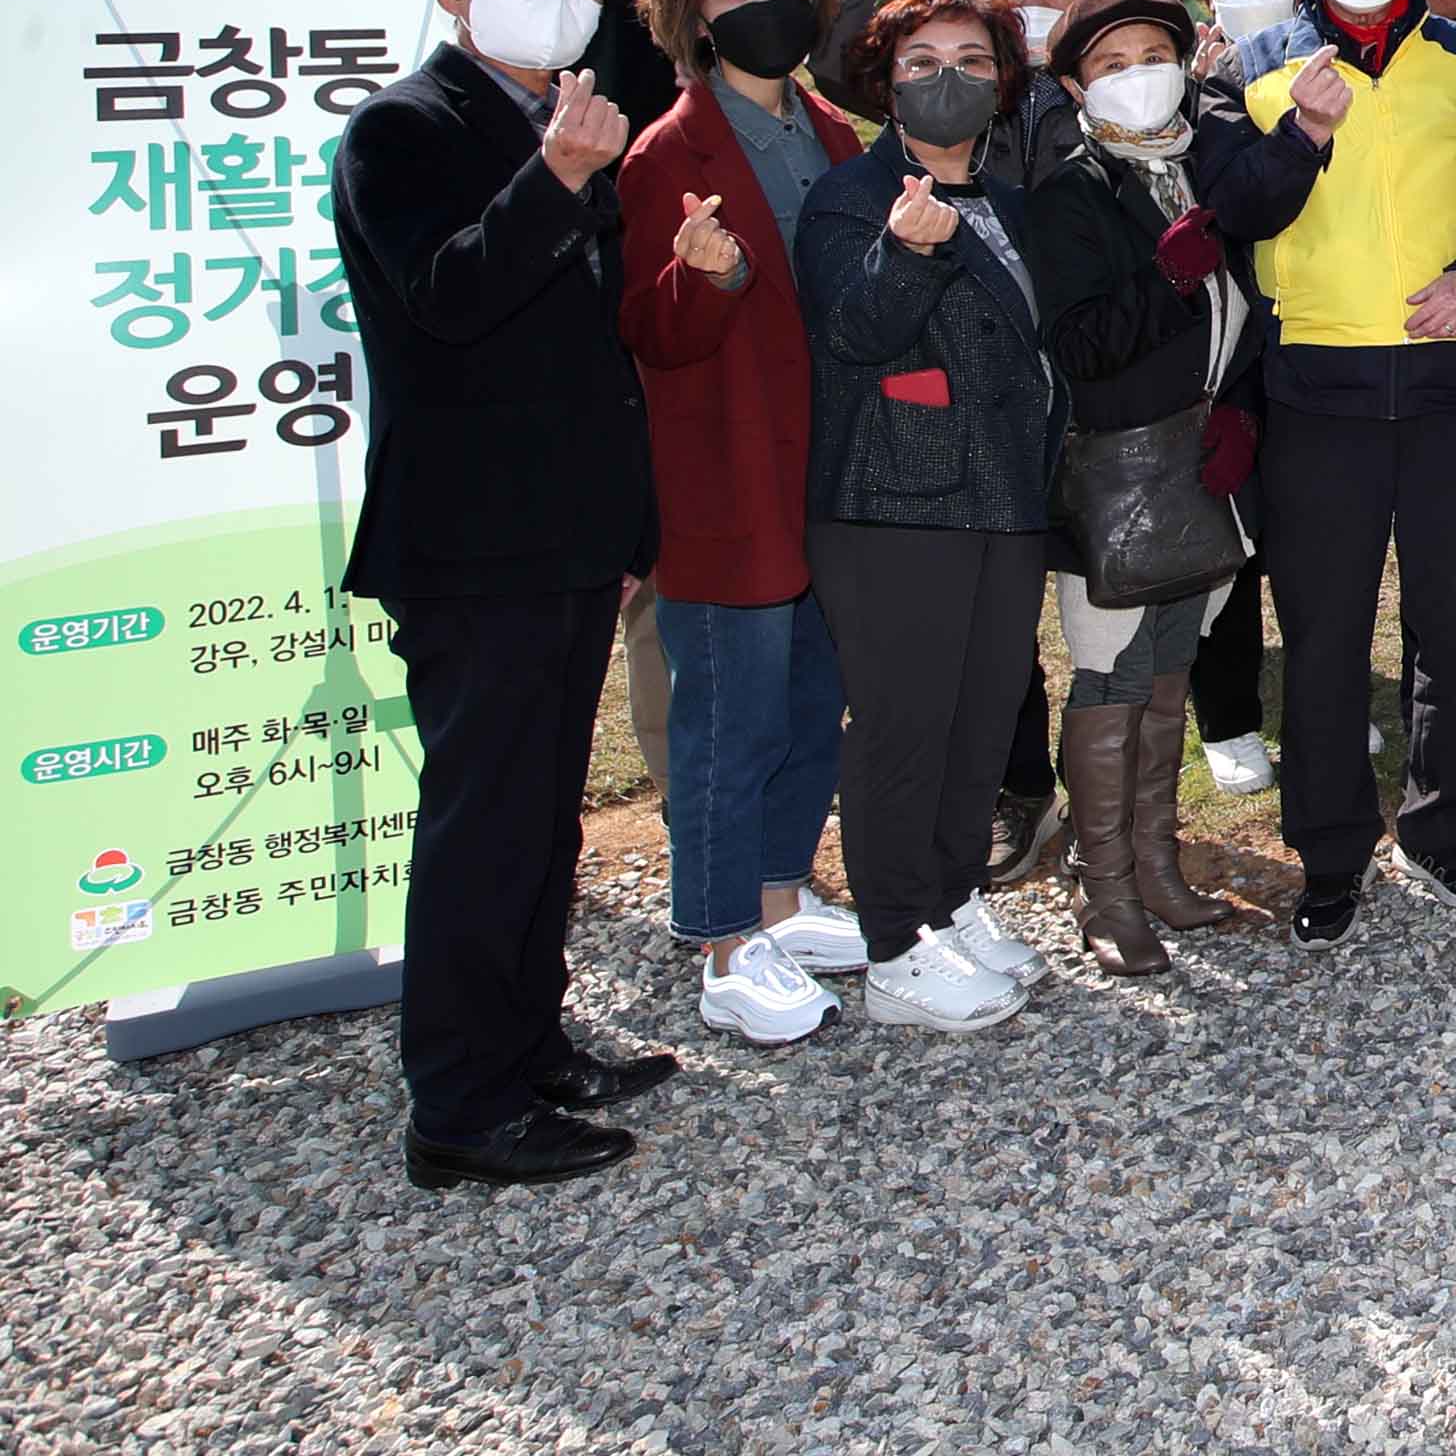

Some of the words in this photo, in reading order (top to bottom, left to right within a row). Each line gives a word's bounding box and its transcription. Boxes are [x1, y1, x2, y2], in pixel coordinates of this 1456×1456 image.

[83, 25, 400, 121] 금창동
[147, 350, 354, 458] 운영
[31, 612, 150, 651] 운영기간
[189, 595, 273, 628] 2022.
[284, 591, 311, 614] 4.
[190, 641, 258, 674] 강우,
[271, 624, 356, 662] 강설시
[193, 724, 251, 756] 매주
[33, 740, 152, 781] 운영시간
[193, 767, 255, 799] 오후
[268, 746, 381, 786] 6시~9시
[166, 838, 256, 875] 금창동
[167, 887, 264, 927] 금창동
